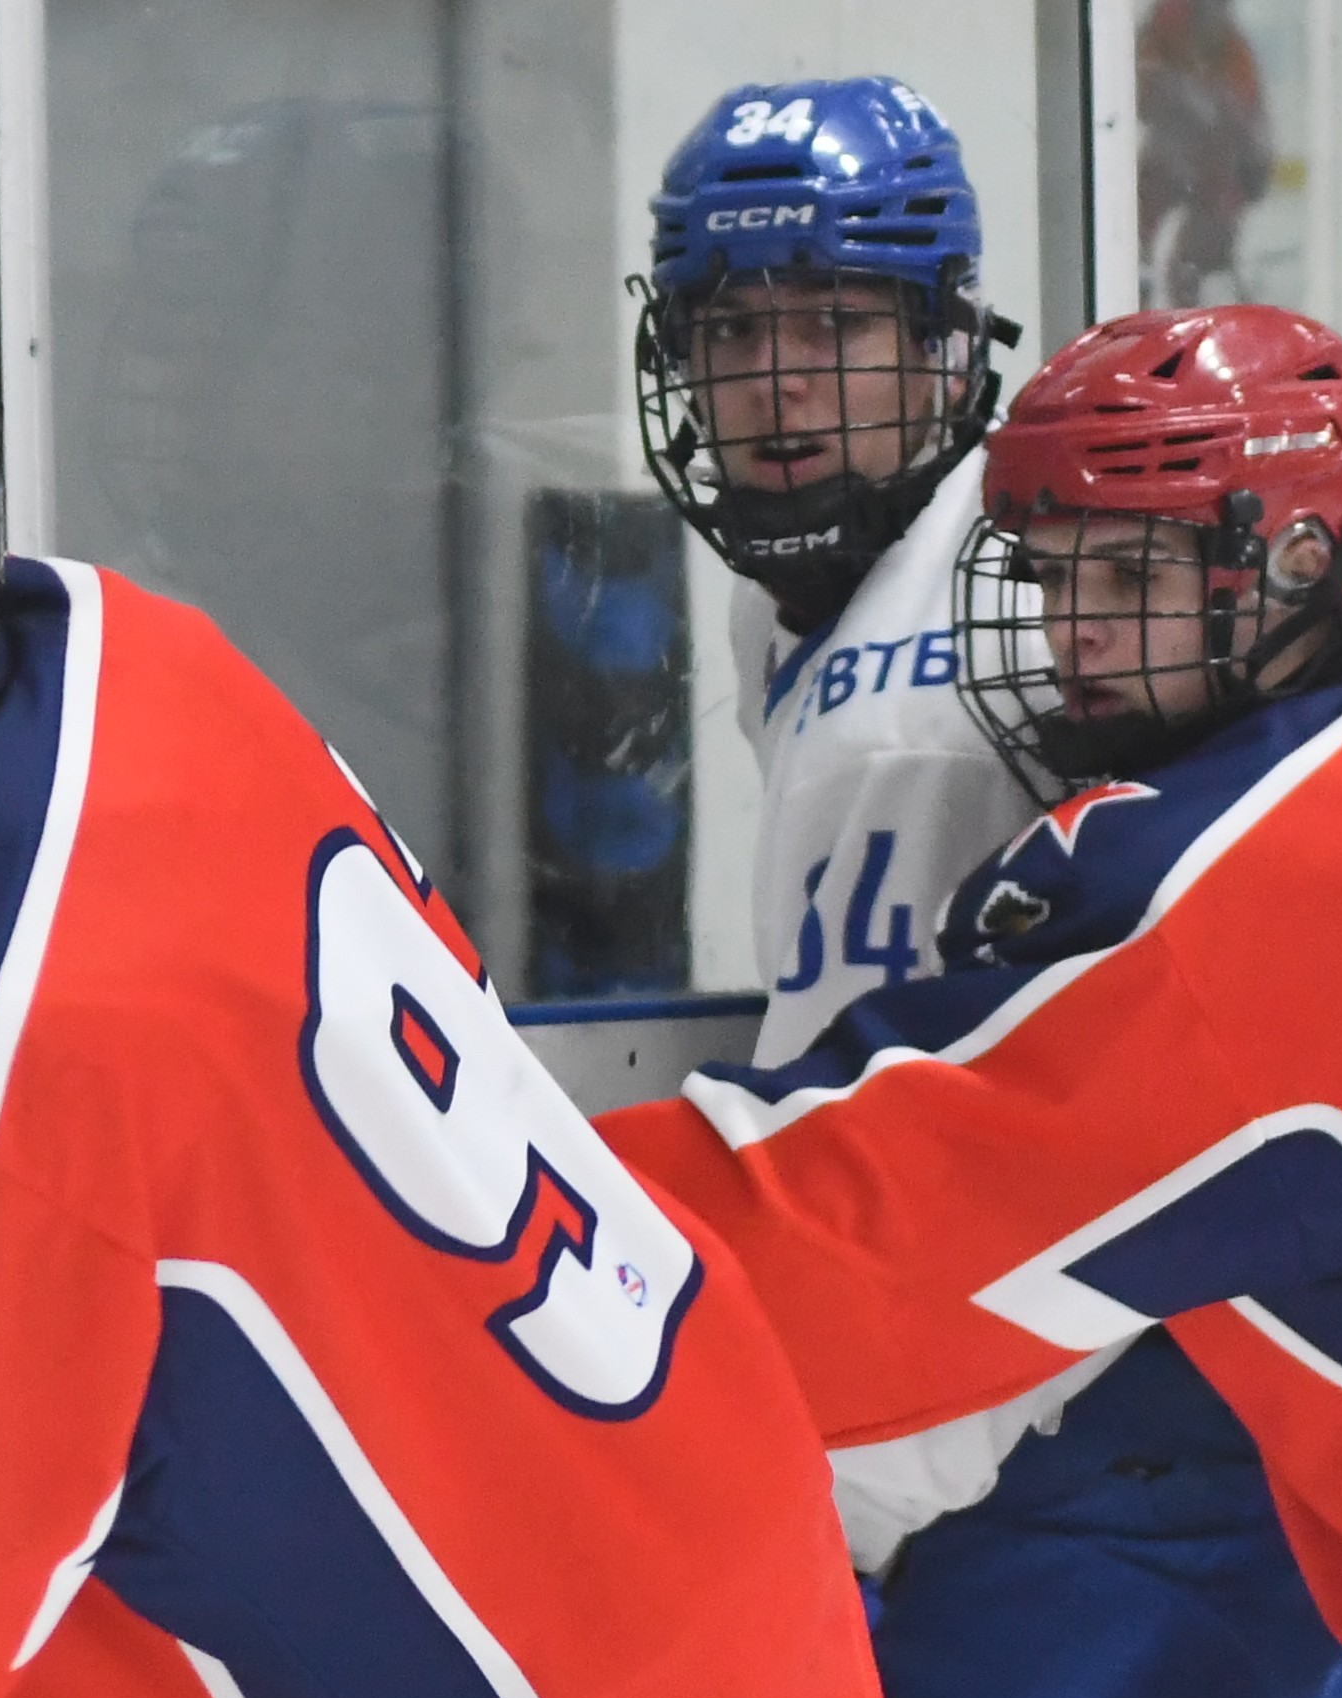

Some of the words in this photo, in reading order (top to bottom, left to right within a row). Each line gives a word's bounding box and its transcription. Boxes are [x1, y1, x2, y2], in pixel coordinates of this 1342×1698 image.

[726, 98, 814, 144] 34
[706, 203, 816, 231] CCM
[745, 524, 841, 556] CCM
[817, 628, 961, 717] ВТБ
